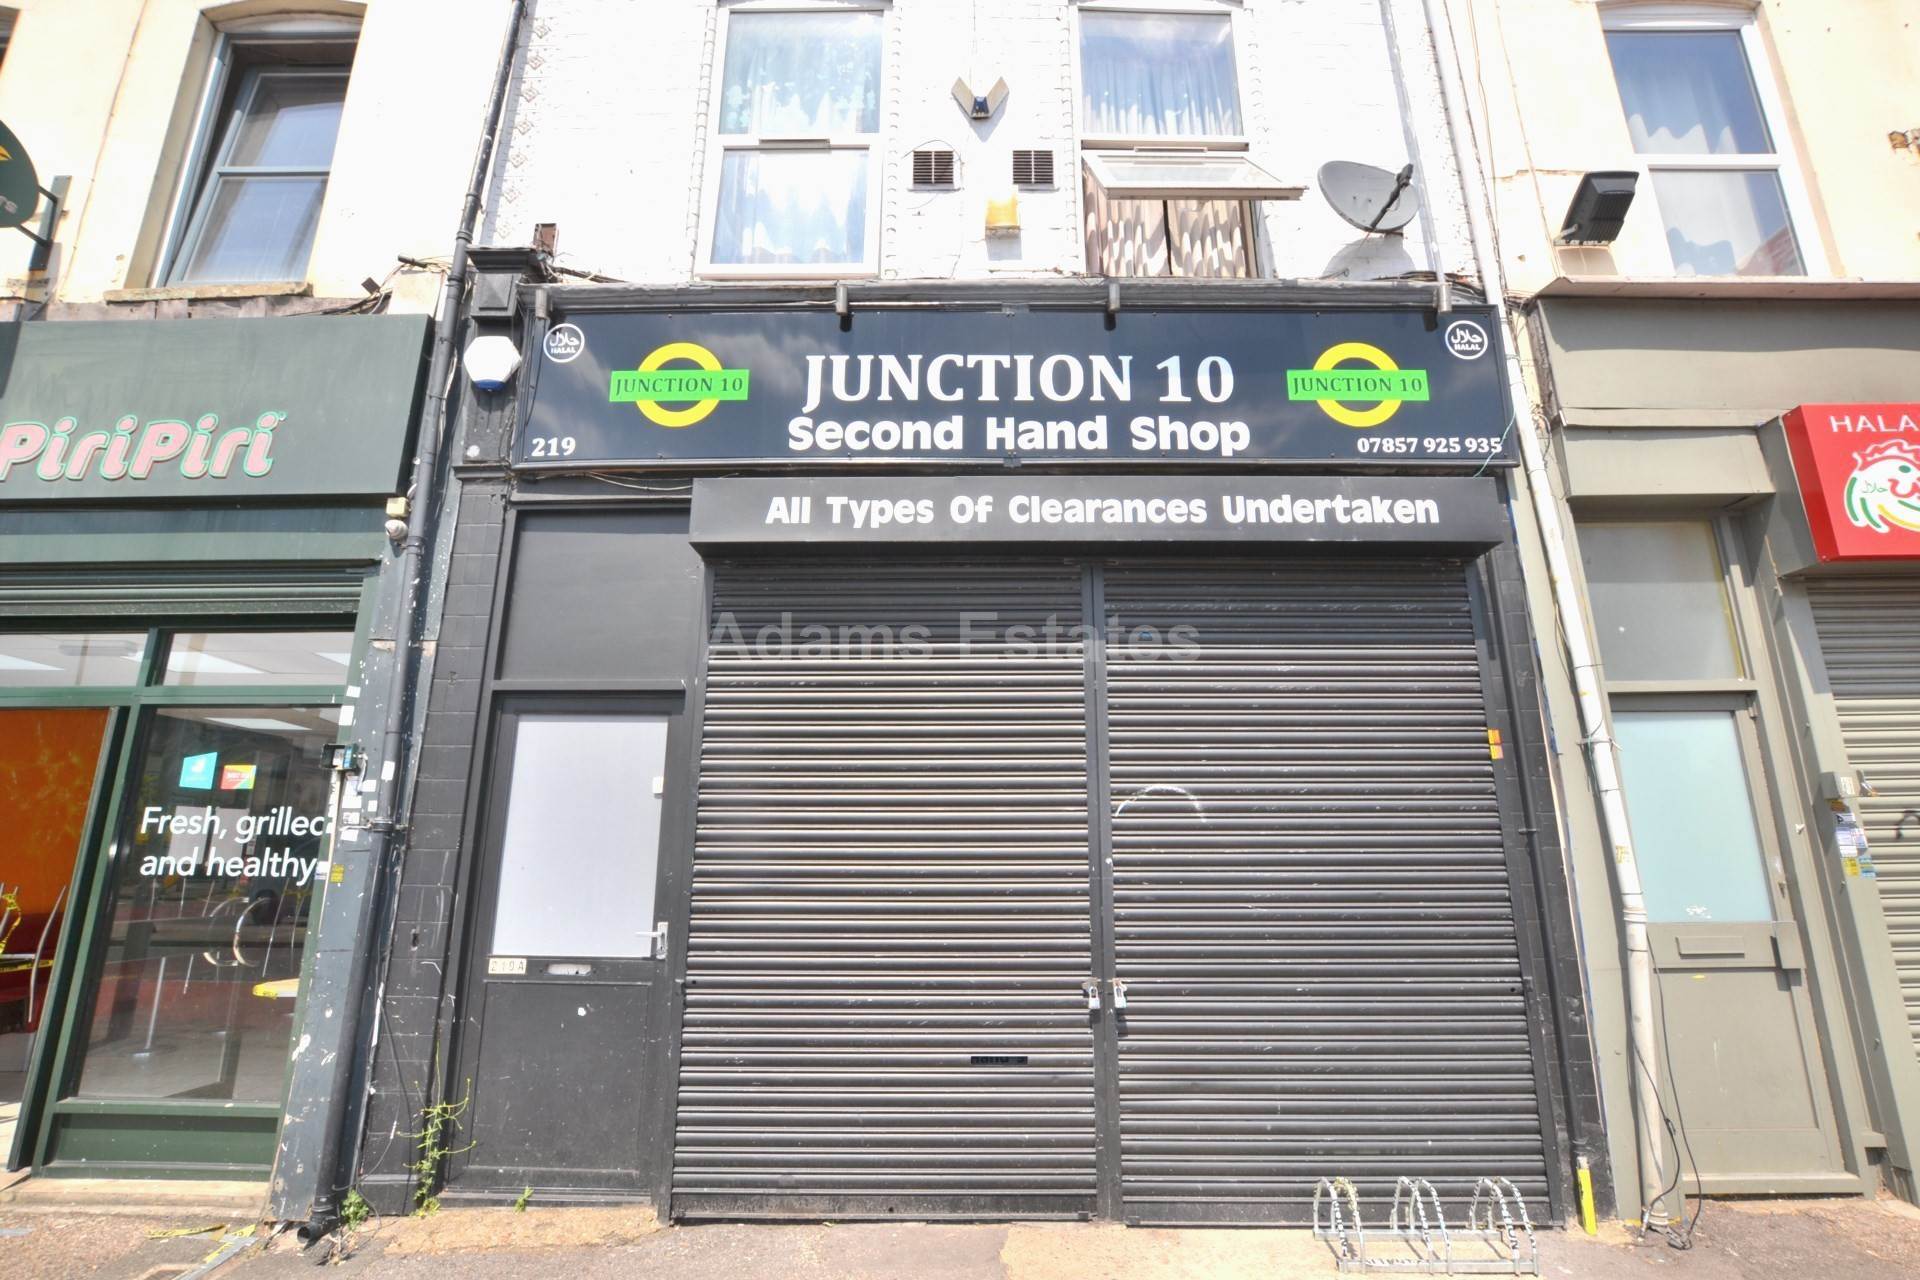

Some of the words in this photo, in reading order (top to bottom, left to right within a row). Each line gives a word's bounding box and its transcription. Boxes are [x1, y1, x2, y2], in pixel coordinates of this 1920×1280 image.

[550, 331, 580, 346] حلال
[1451, 328, 1482, 343] حلال
[616, 377, 712, 396] JUNCTION
[719, 377, 743, 392] 10
[802, 354, 1133, 412] JUNCTION
[1156, 355, 1234, 403] 10
[1293, 377, 1392, 395] JUNCTION
[1399, 377, 1422, 392] 10
[788, 415, 964, 451] Second
[987, 415, 1107, 451] Hand
[1130, 415, 1250, 456] Shop
[1356, 437, 1418, 453] 07857
[1423, 437, 1461, 453] 925
[1464, 437, 1503, 453] 935
[531, 437, 576, 457] 219
[765, 496, 811, 524] All
[826, 496, 934, 529] Types
[950, 495, 993, 524] Of
[1008, 495, 1208, 524] Clearances
[1222, 494, 1440, 524] Undertaken
[140, 806, 228, 840] Fresh,
[140, 847, 199, 876] and
[205, 847, 318, 887] healthy
